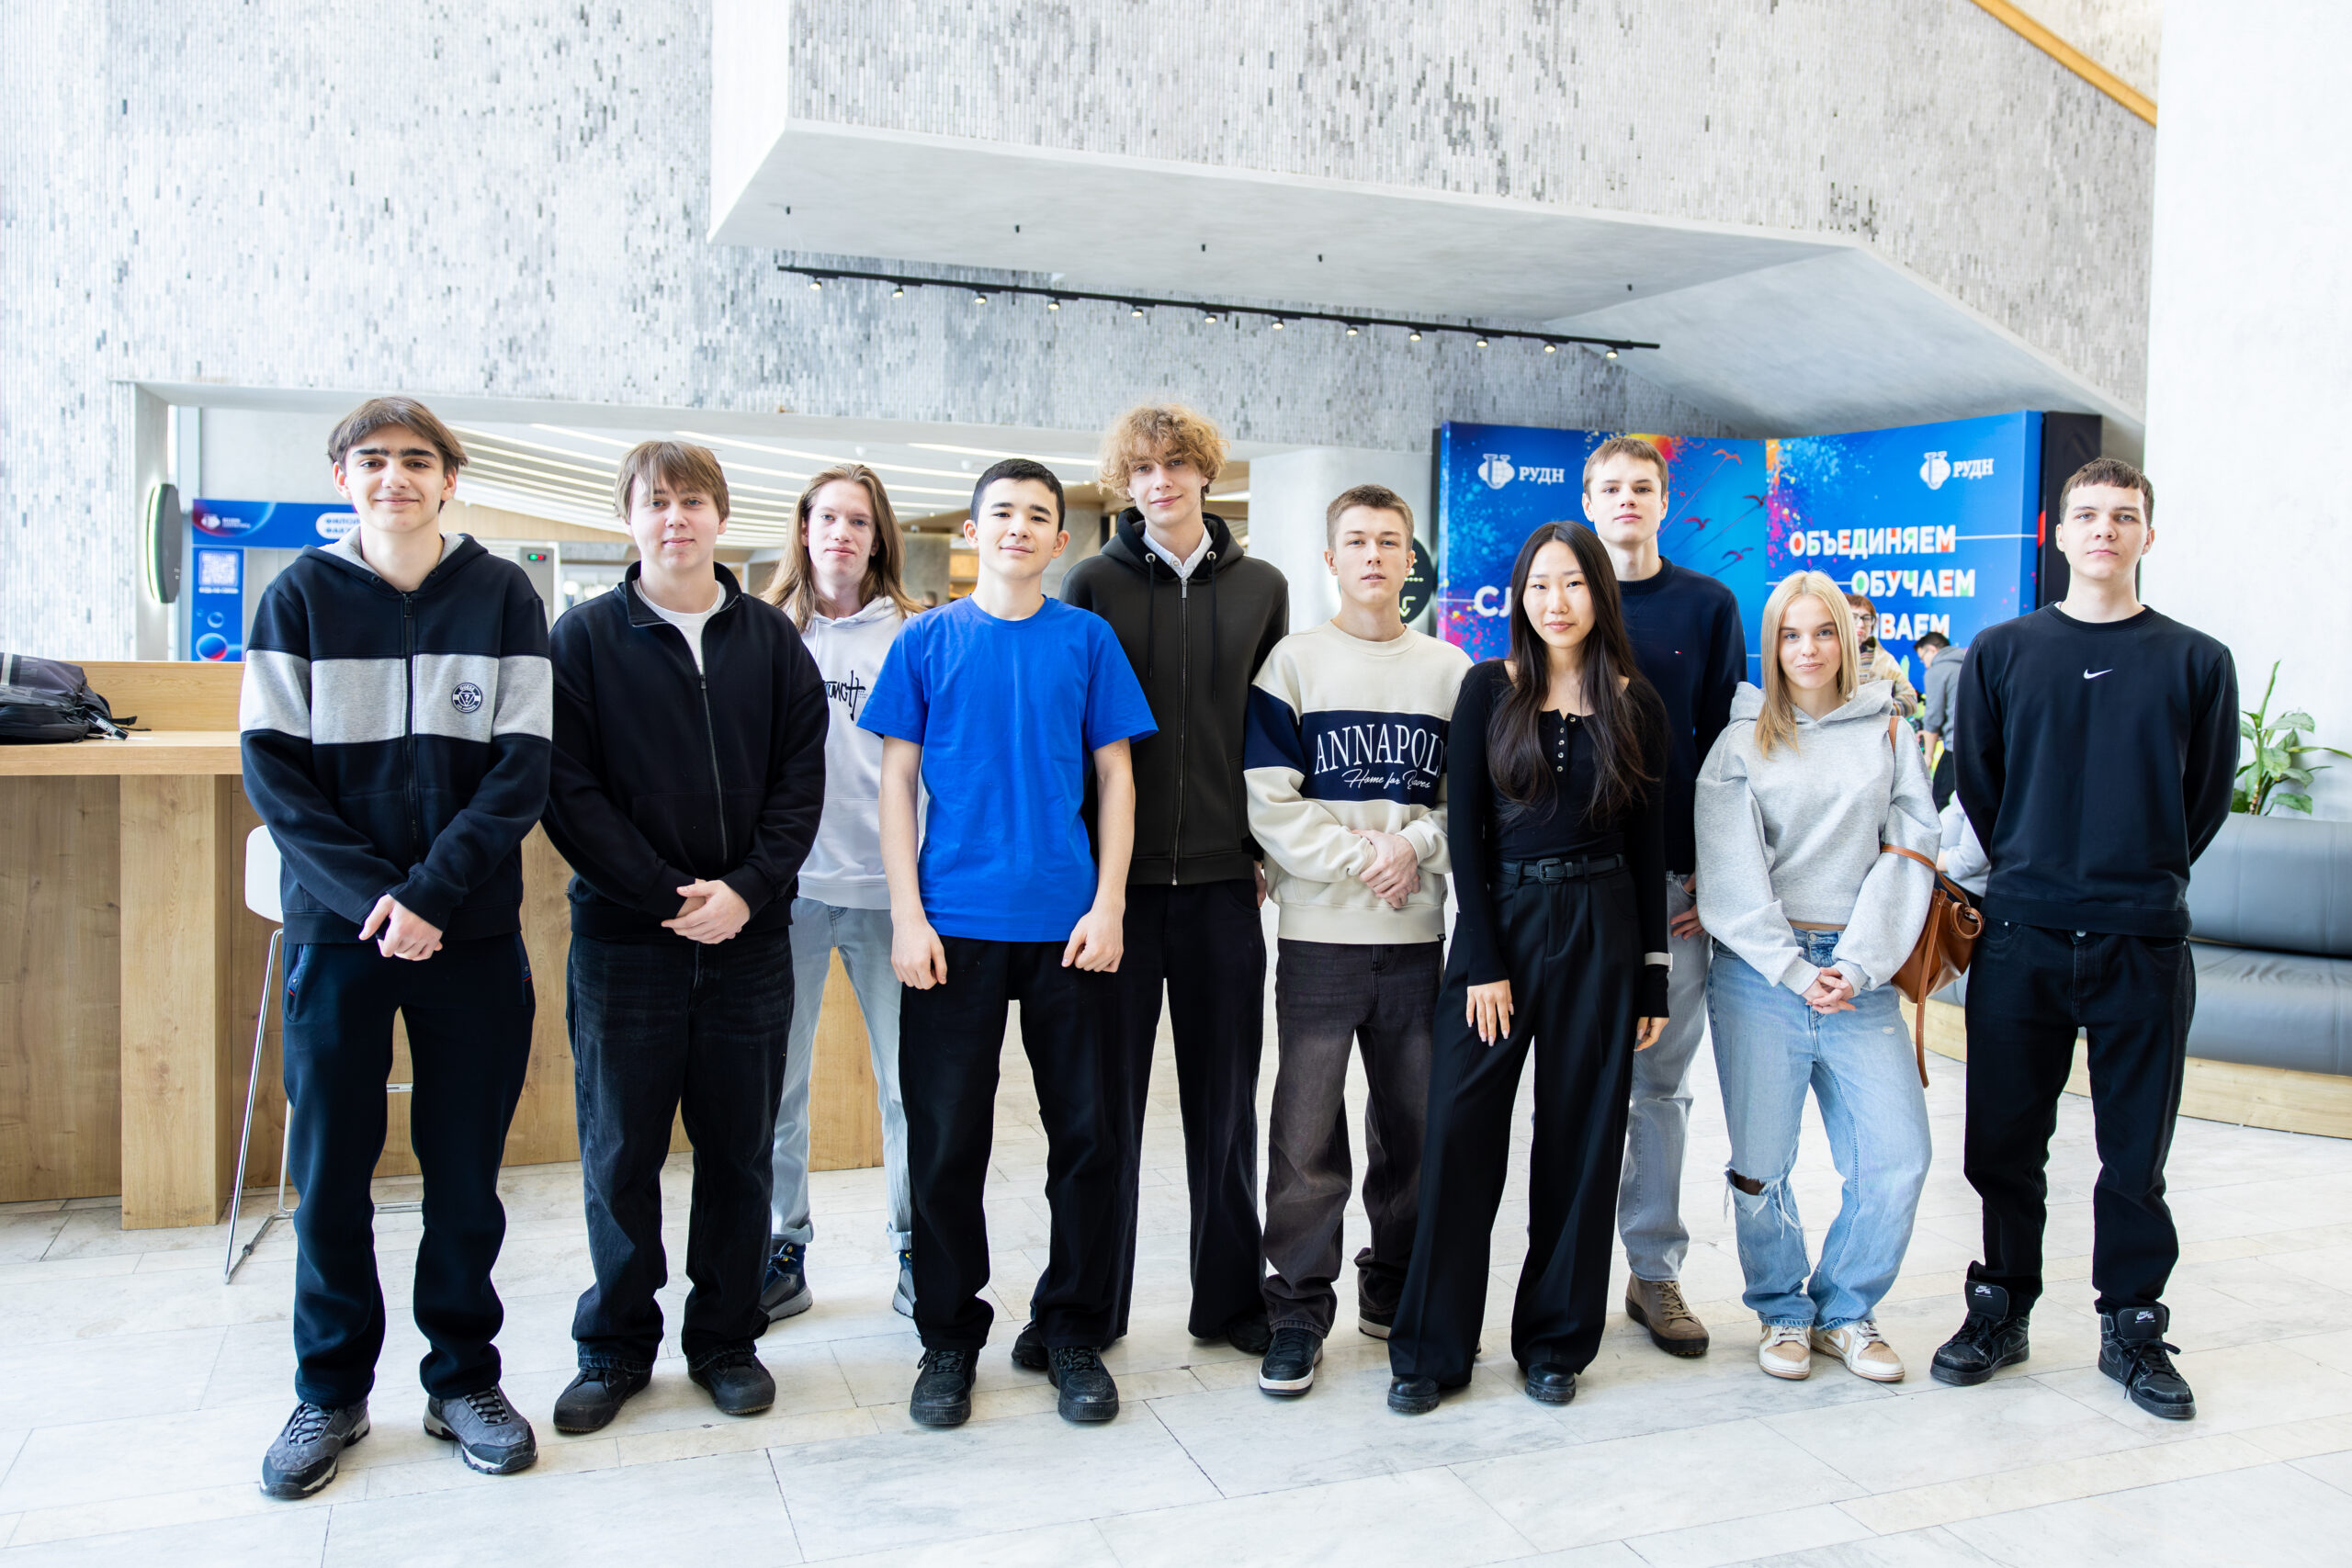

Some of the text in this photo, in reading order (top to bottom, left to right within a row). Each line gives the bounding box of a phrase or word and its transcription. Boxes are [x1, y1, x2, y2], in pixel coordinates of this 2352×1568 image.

[1519, 466, 1565, 485] РУДН
[1952, 457, 1995, 479] РУДН
[1788, 525, 1956, 560] ОБЪЕДИНЯЕМ
[1851, 569, 1975, 598] ОБУЧАЕМ
[1341, 768, 1385, 789] Home
